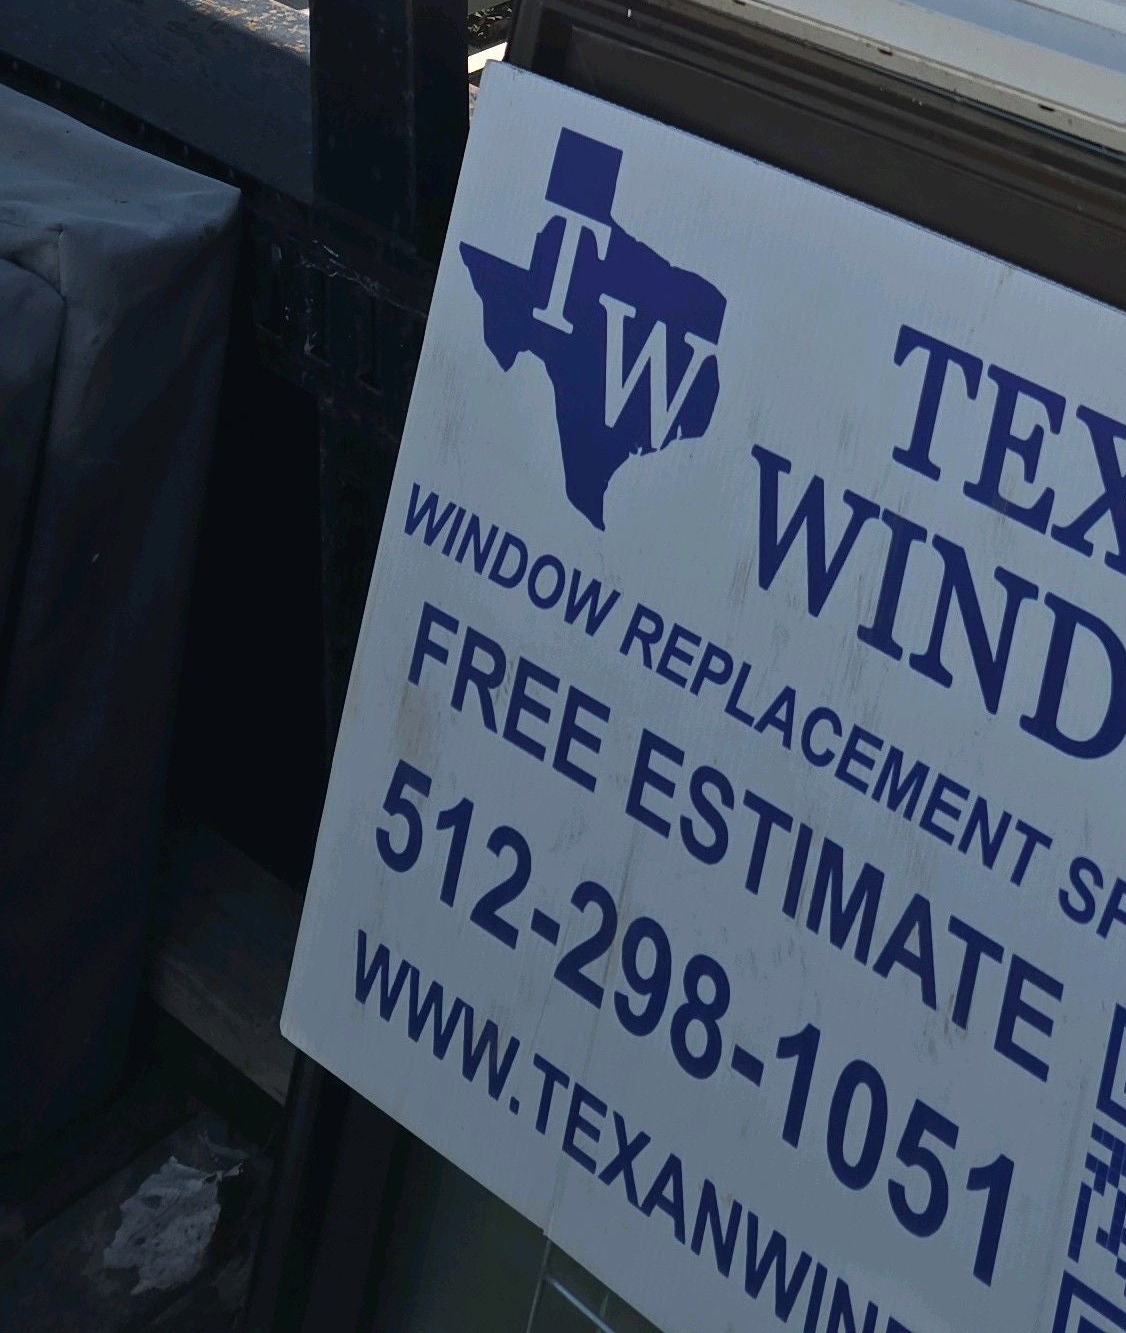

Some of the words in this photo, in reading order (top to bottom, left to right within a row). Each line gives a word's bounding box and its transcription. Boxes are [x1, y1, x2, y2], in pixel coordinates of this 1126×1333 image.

[403, 482, 621, 637] WINDOW
[619, 602, 1052, 887] REPLACEMENT
[407, 601, 611, 793] FREE
[625, 728, 1064, 1083] ESTIMATE
[354, 928, 914, 1333] WWW.TEXANWIN
[375, 758, 1015, 1287] 512-298-1051
